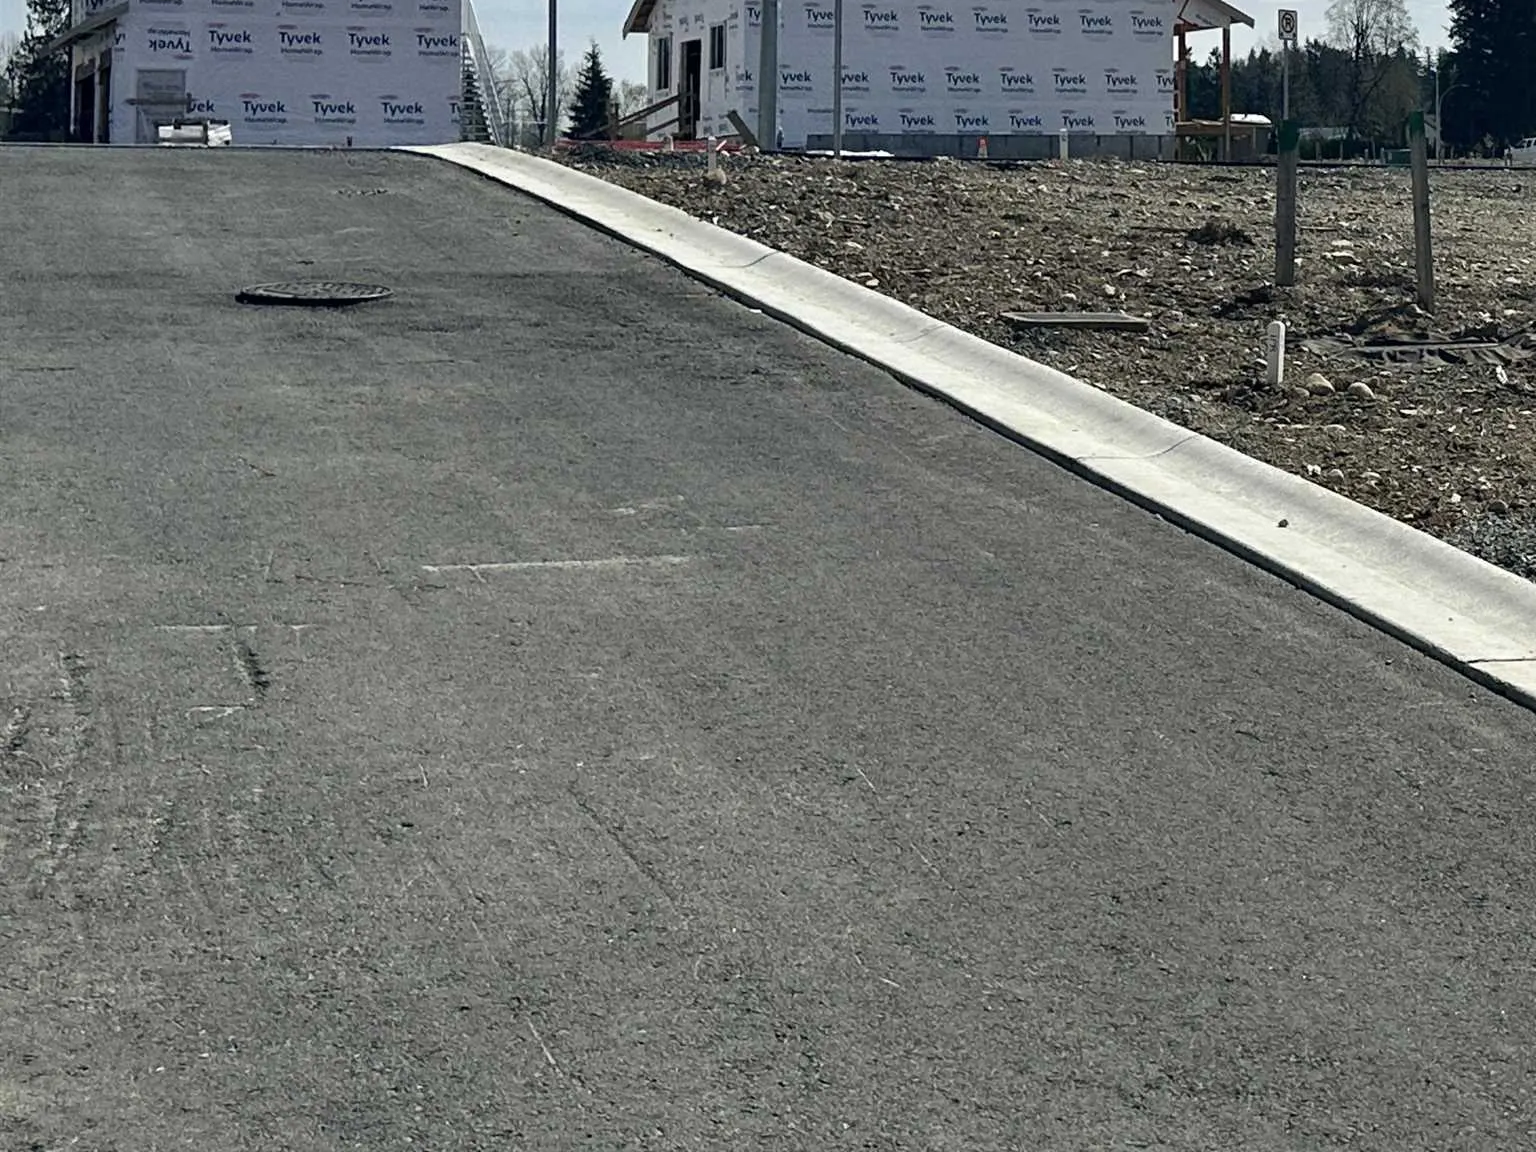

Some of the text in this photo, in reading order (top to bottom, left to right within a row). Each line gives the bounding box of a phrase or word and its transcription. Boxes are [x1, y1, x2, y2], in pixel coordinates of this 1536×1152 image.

[805, 8, 834, 21] Tyve
[863, 10, 898, 23] Tyvek
[919, 11, 954, 24] Tyvek
[973, 12, 1007, 26] Tyvek
[1027, 14, 1060, 27] Tyvek
[1079, 15, 1112, 28] Tyvek
[1131, 16, 1163, 29] Tyvek
[209, 30, 251, 45] Tyvek
[279, 31, 321, 46] Tyvek
[348, 33, 390, 48] Tyvek
[416, 34, 458, 48] Tyvek
[148, 38, 192, 53] Tyvek
[781, 70, 812, 84] yvek
[842, 72, 869, 84] yvek
[890, 71, 925, 85] Tyvek
[946, 72, 980, 86] Tyvek
[1000, 73, 1033, 86] Tyvek
[1053, 74, 1086, 87] Tyvek
[1104, 74, 1138, 87] Tyvek
[1156, 75, 1175, 87] Tyv
[190, 99, 215, 113] vek
[242, 100, 286, 116] Tyvek
[312, 101, 355, 116] Tyvek
[381, 102, 423, 117] Tyvek
[845, 114, 879, 127] Tyvek
[899, 115, 935, 128] Tyvek
[954, 115, 989, 128] Tyvek
[1009, 116, 1042, 128] Tyvek
[1062, 116, 1096, 129] Tyvek
[1113, 116, 1146, 129] Tyvek
